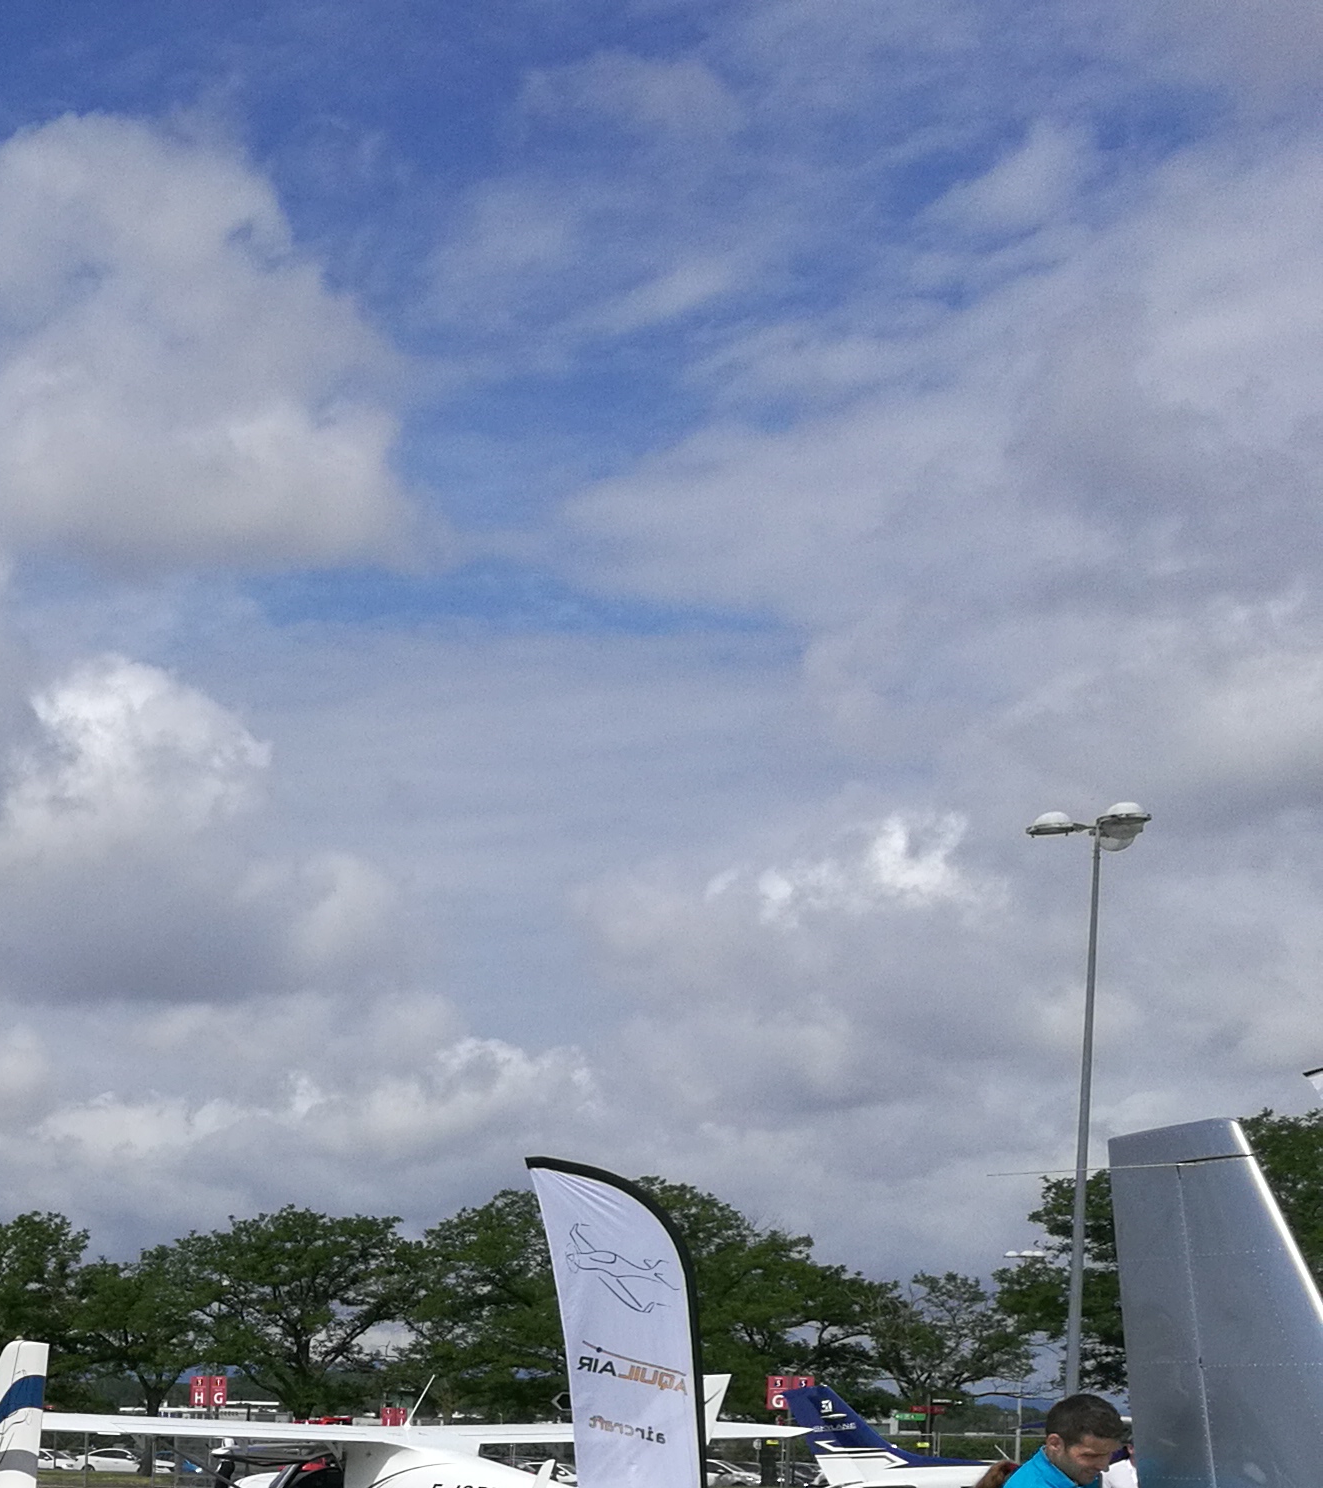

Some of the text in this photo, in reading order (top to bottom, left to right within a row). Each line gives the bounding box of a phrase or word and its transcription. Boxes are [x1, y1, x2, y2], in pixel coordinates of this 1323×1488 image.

[195, 1392, 204, 1404] H
[214, 1392, 223, 1404] G
[772, 1394, 784, 1408] G
